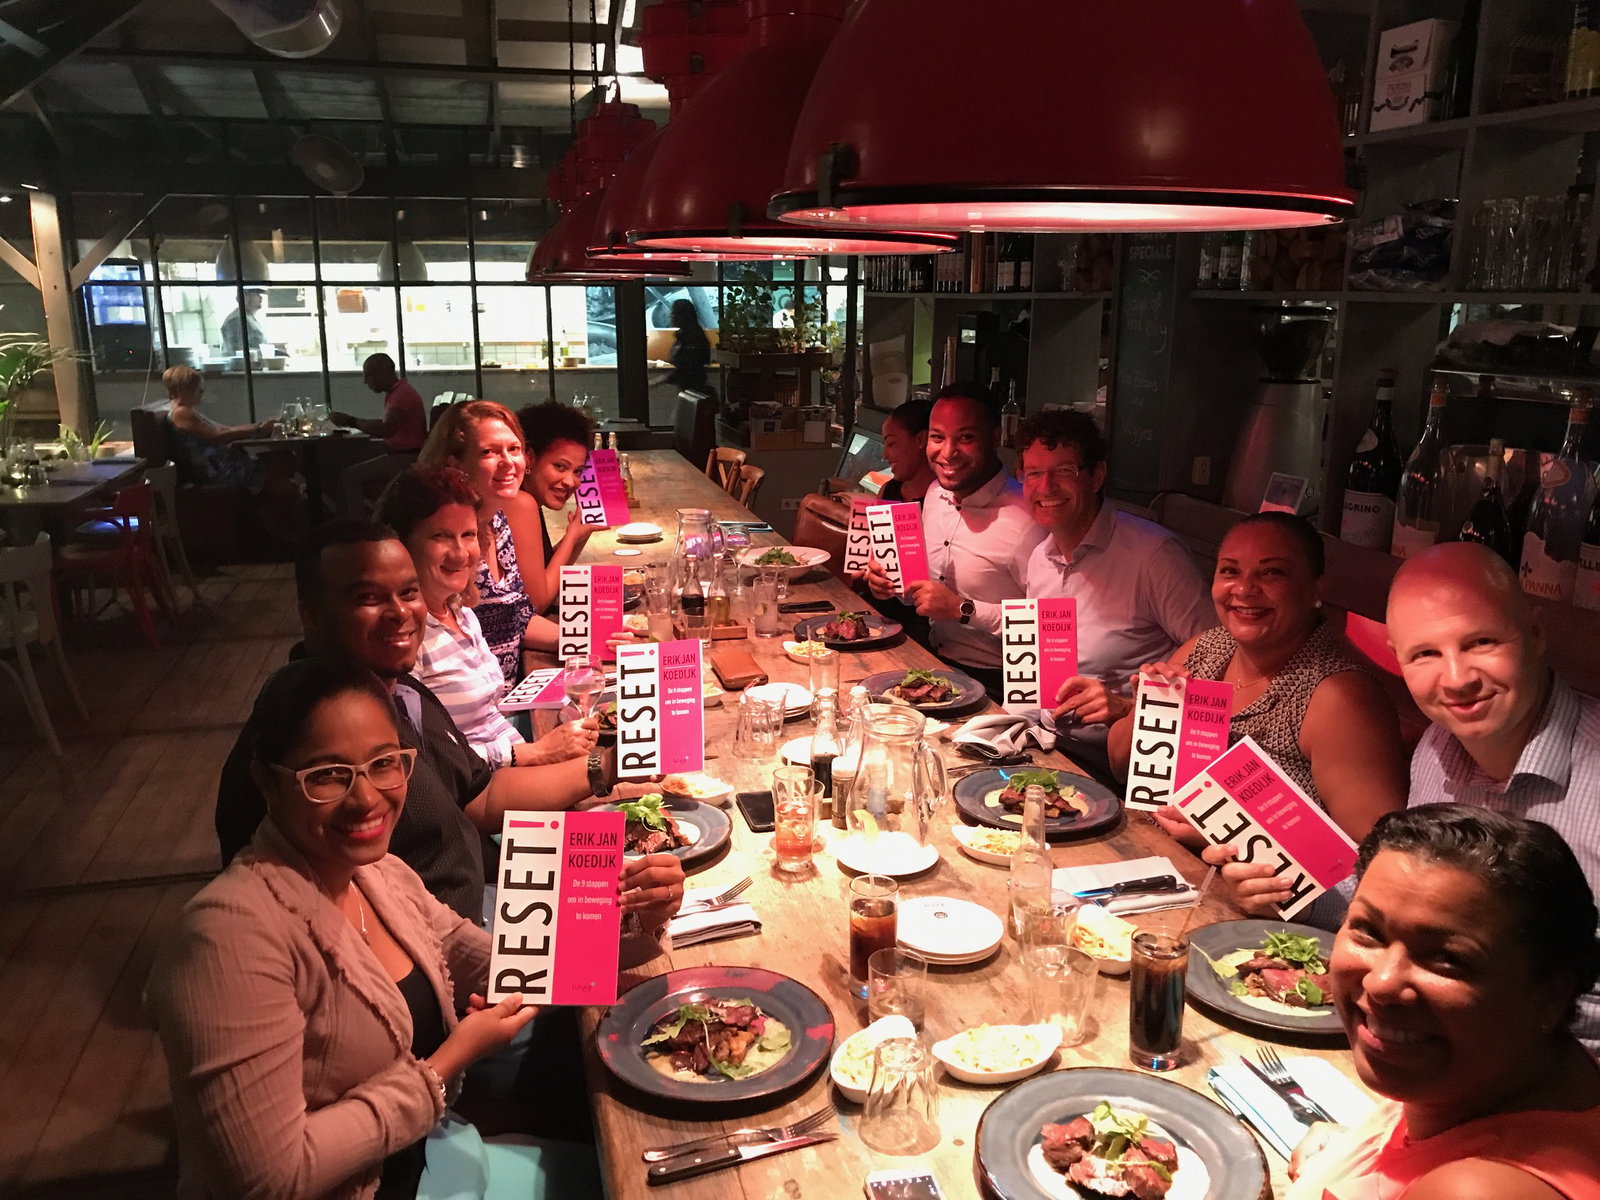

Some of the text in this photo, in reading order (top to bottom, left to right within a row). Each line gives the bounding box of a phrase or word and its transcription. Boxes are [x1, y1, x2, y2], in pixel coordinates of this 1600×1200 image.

[562, 570, 589, 658] RESET!
[1041, 610, 1072, 619] ERIK JAN
[1042, 623, 1072, 632] KOEDIJK
[663, 653, 696, 666] ERIK JAN
[1005, 604, 1038, 704] RESET!
[663, 668, 697, 681] KOEDIJK
[1189, 694, 1227, 708] ERIK JAN
[620, 649, 656, 770] RESET!
[1187, 710, 1226, 725] KOEDIJK
[1130, 680, 1183, 806] RESET!
[1223, 758, 1261, 789] ERIK JAN
[1238, 773, 1276, 804] KOEDIJK
[569, 832, 617, 846] ERIK JAN
[568, 854, 617, 868] KOEDIJK
[572, 879, 609, 889] De 9 stappen
[494, 820, 560, 994] RESET!
[577, 896, 584, 904] in
[584, 896, 613, 906] beweging
[575, 912, 602, 920] te komen
